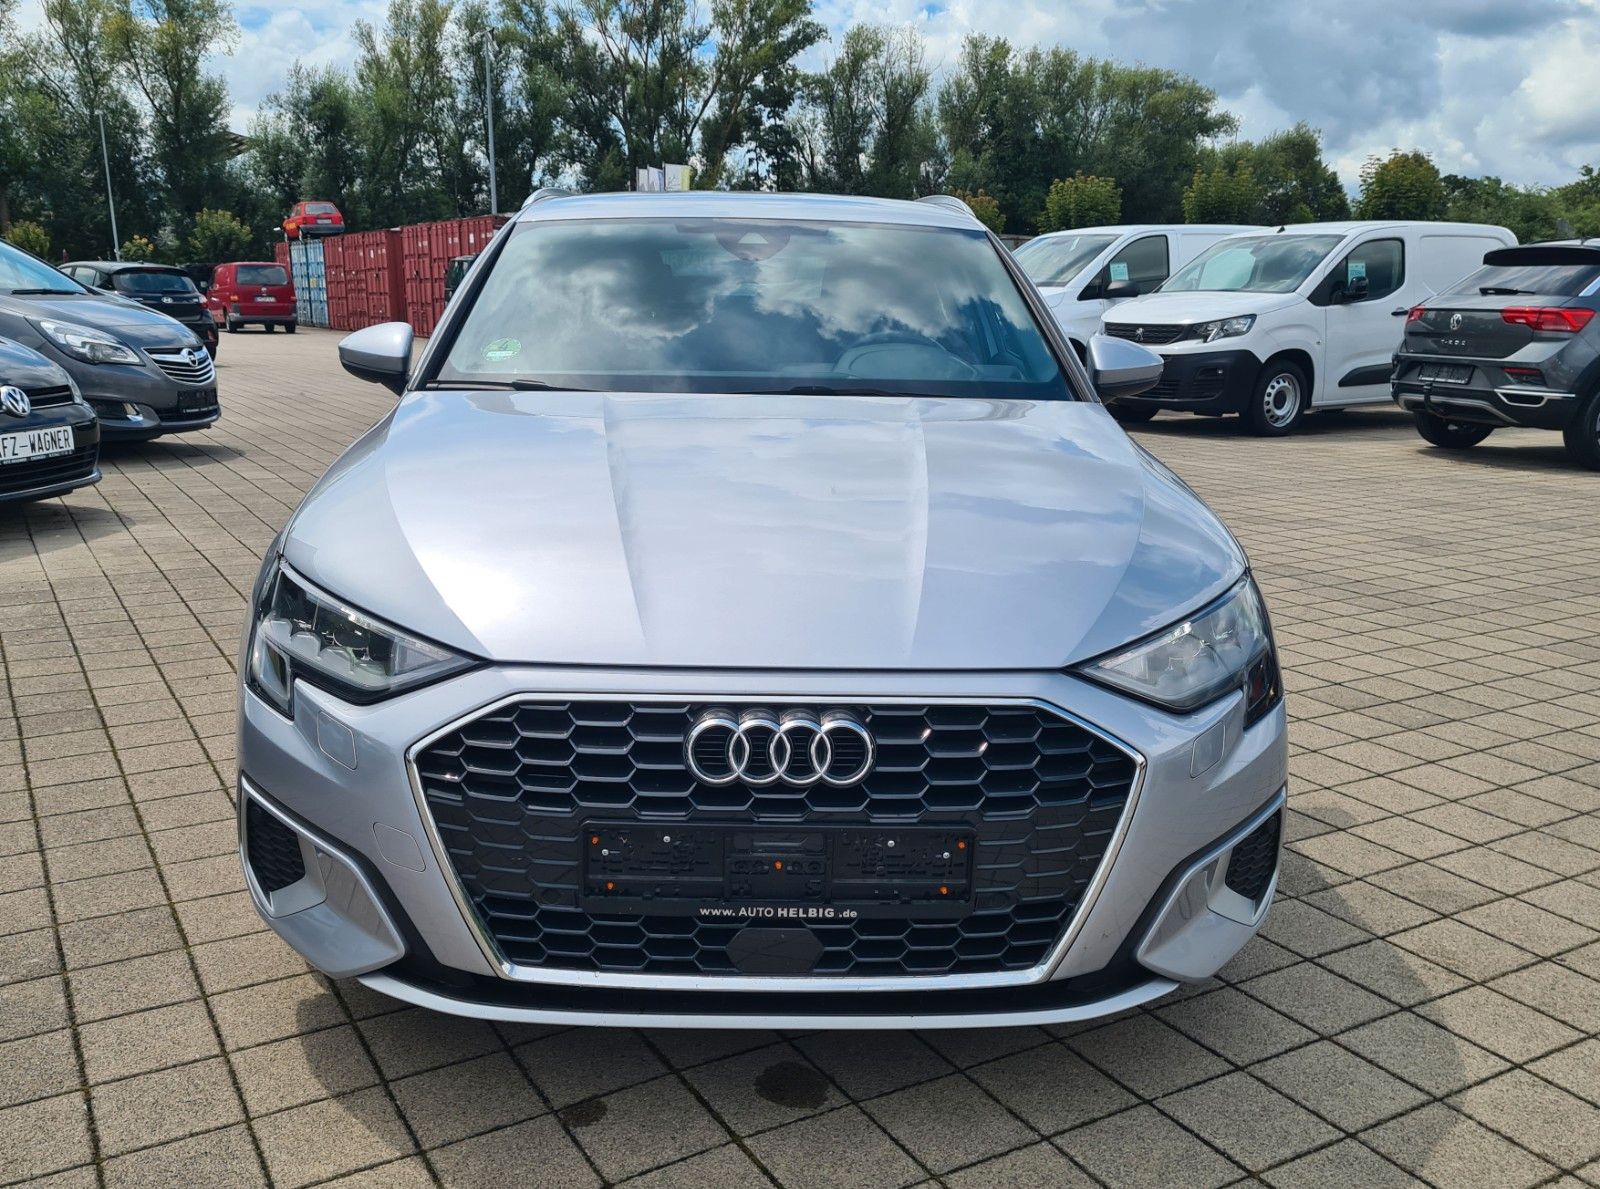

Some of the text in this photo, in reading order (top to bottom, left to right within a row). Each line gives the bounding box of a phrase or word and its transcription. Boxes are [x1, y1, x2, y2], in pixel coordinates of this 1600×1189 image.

[0, 429, 71, 458] FZ-WAGNER
[700, 907, 858, 918] www. AUTO HELBIG .de
